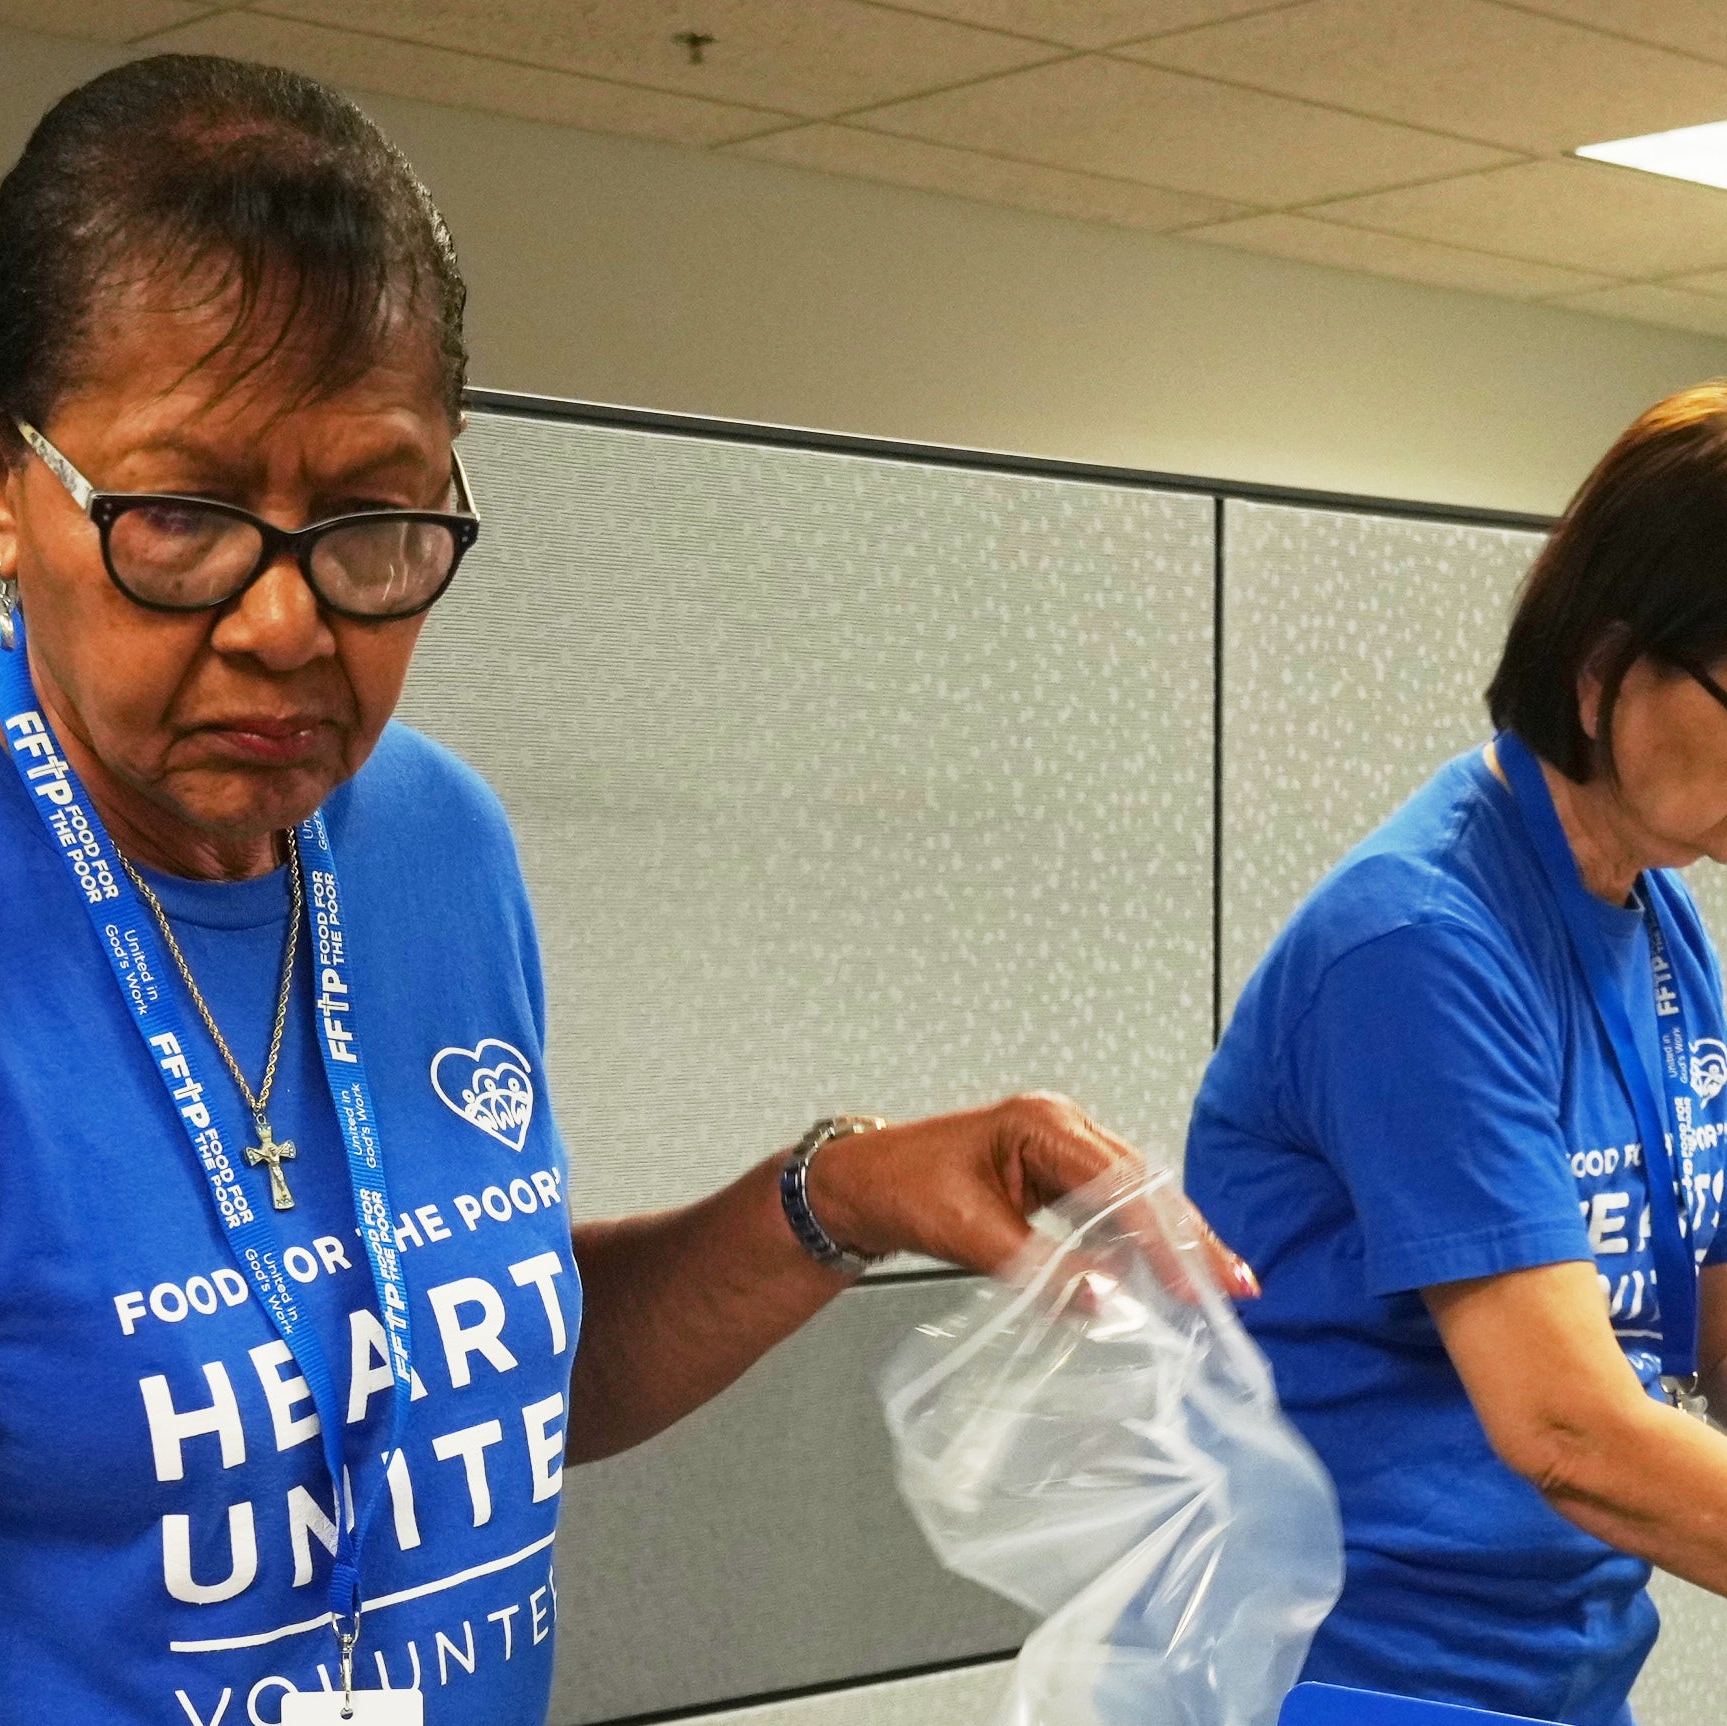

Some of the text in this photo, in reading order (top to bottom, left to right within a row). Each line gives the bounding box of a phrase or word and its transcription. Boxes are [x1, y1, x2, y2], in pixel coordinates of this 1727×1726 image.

[49, 810, 103, 904] THE POOR
[64, 804, 119, 900] FOOD FOR
[312, 870, 331, 965] FOOD FOR
[324, 872, 345, 966] THE POOR
[105, 924, 149, 1016] God's Work
[124, 929, 158, 1001] United in
[340, 1090, 363, 1156] United in
[351, 1082, 377, 1169] God's Work
[1565, 1148, 1619, 1179] OOD
[193, 1132, 241, 1230] THE POOR
[204, 1127, 254, 1225] FOOD FOR
[113, 1268, 249, 1336] FOOD
[283, 1235, 352, 1284] OR
[356, 1203, 452, 1252] HE
[359, 1188, 390, 1279] FOOD FOR
[371, 1190, 402, 1282] THE POOR
[245, 1247, 294, 1335] God's Work
[262, 1251, 299, 1322] United in
